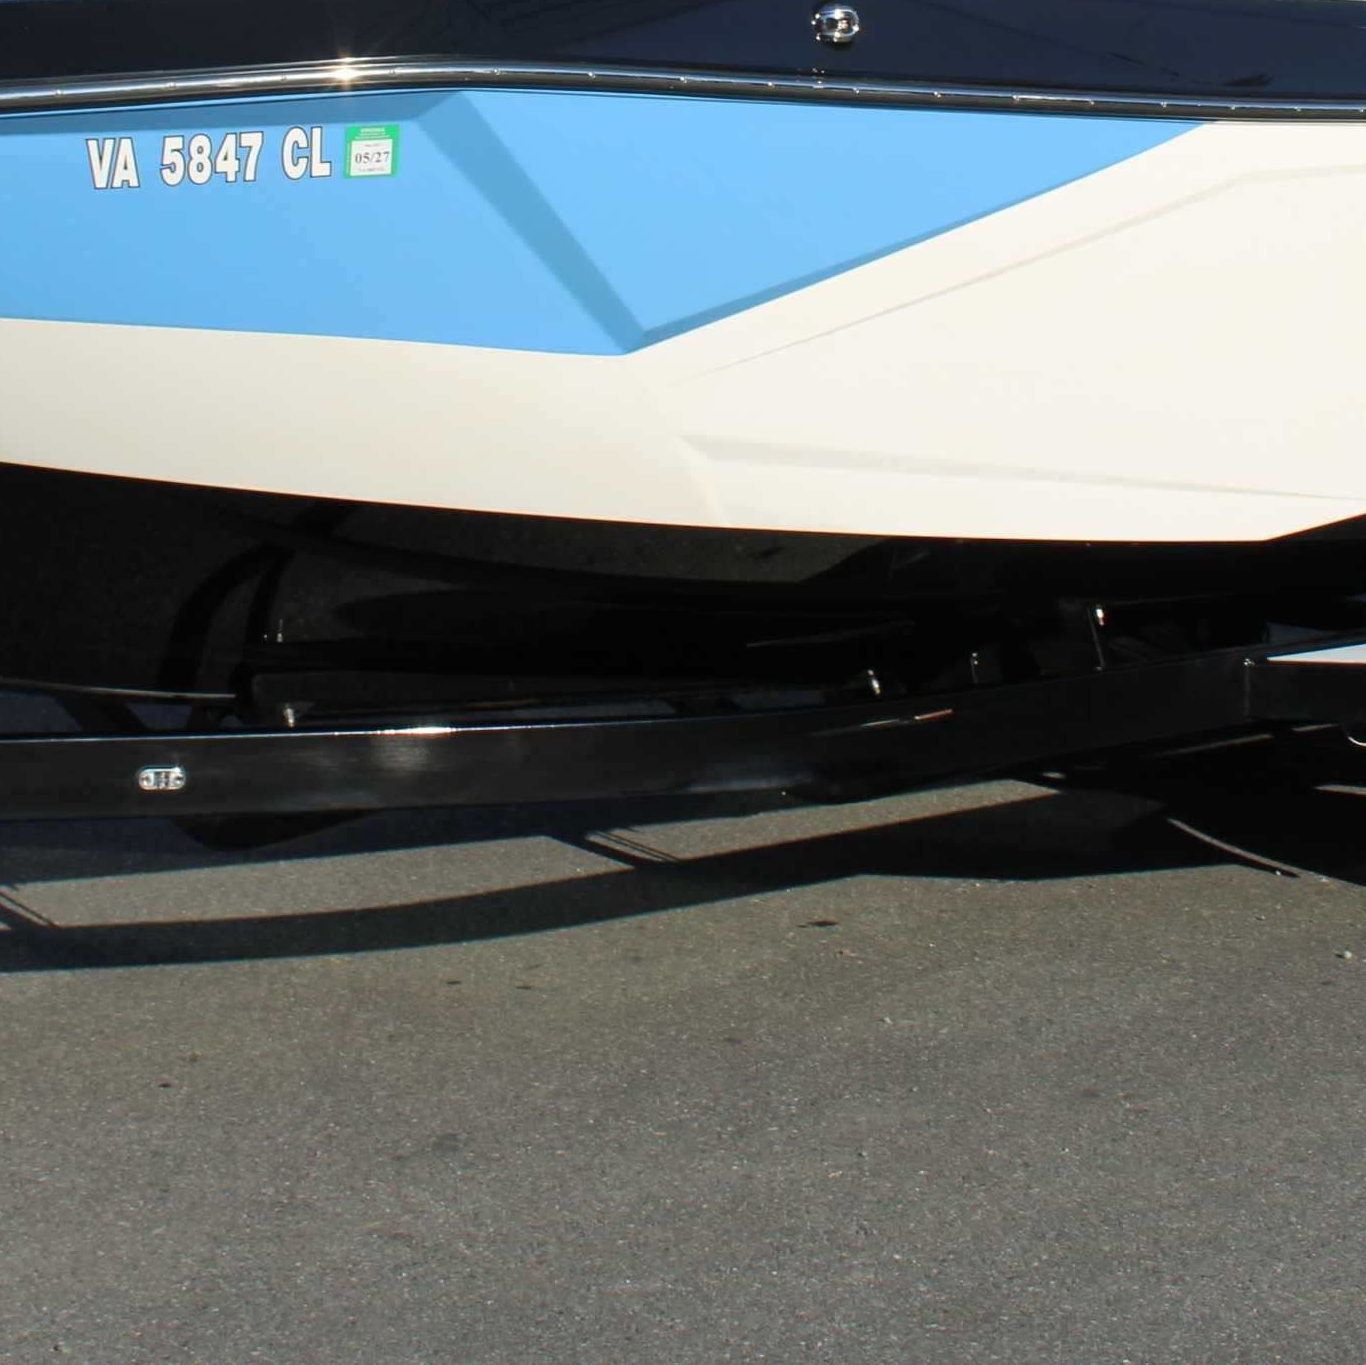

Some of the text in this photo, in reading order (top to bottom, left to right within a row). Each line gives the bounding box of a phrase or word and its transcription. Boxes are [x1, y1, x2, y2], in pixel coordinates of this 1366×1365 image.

[86, 125, 332, 190] VA 5847 CL
[355, 150, 390, 164] 05/27
